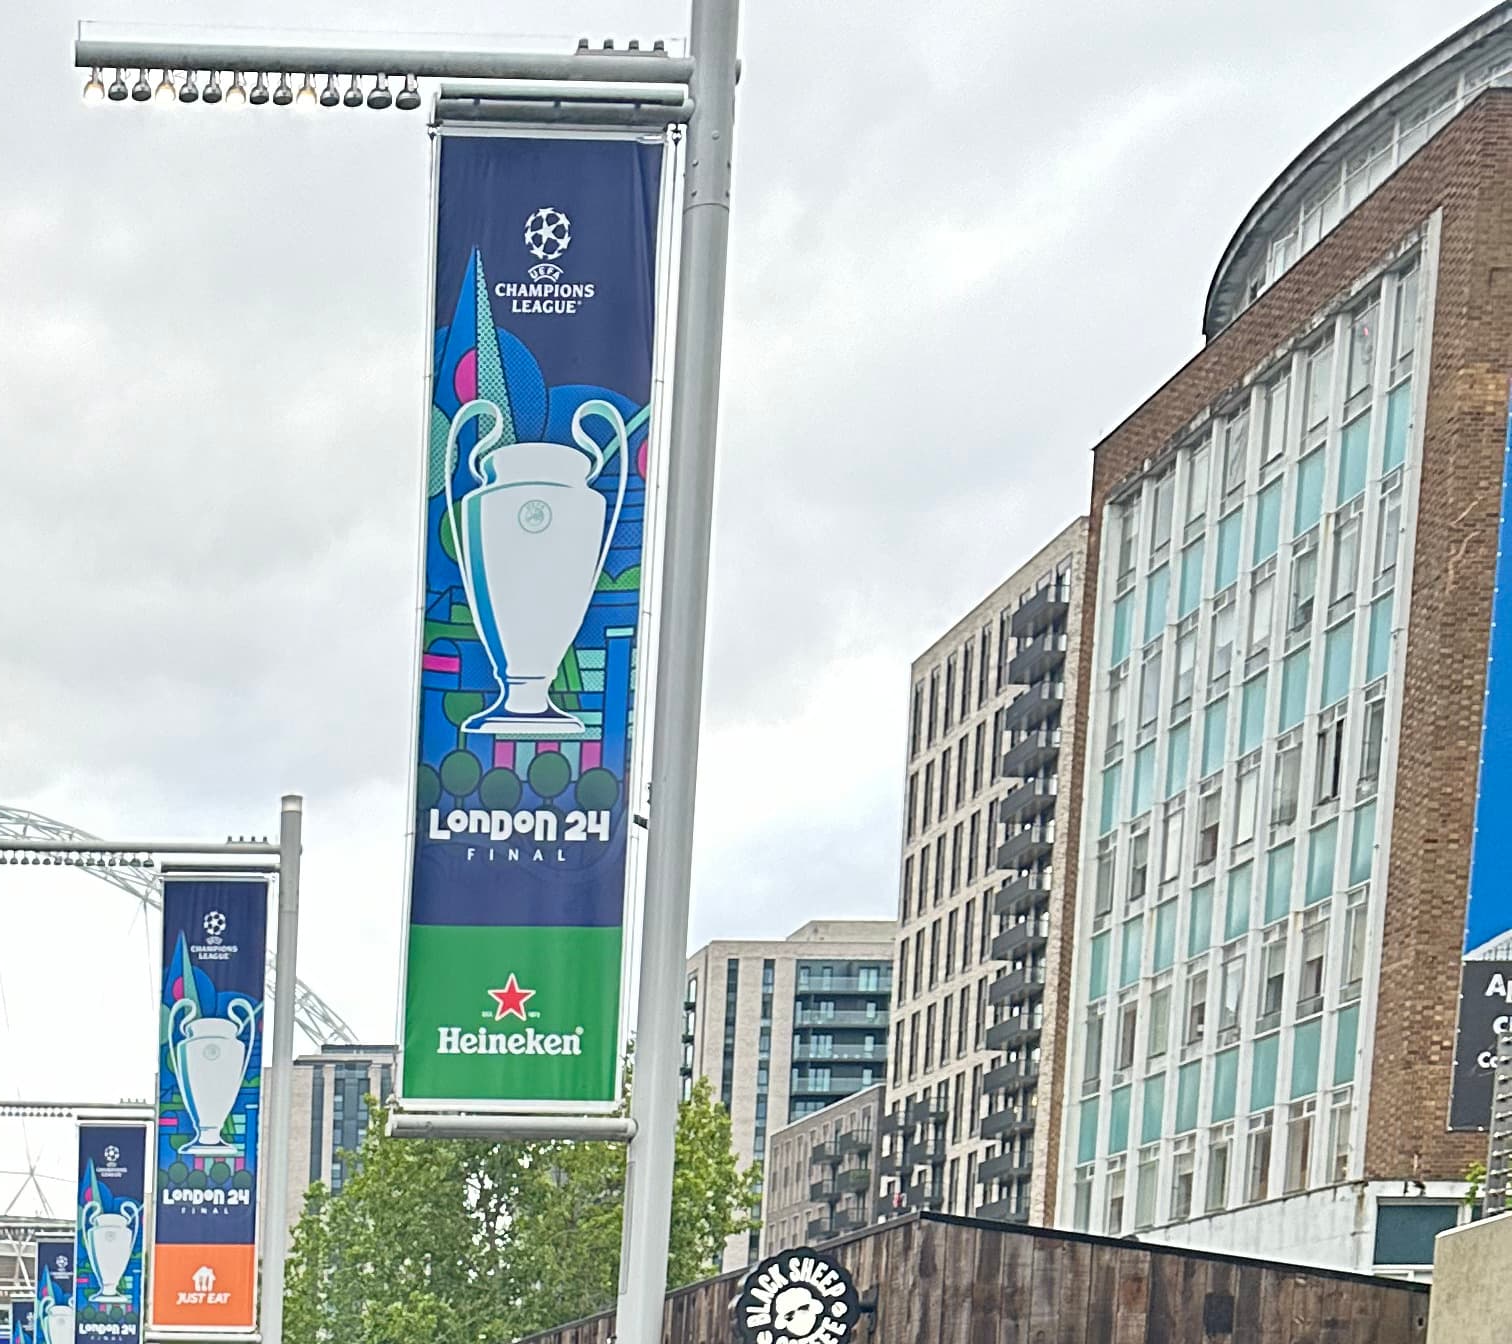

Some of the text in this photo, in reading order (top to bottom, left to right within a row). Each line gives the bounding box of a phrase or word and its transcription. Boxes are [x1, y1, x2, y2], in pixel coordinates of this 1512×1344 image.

[529, 266, 560, 280] UEFA
[494, 283, 595, 298] CHAMPIONS
[512, 299, 577, 313] LEAGUE
[564, 810, 610, 841] 24
[467, 847, 565, 862] FINAL
[437, 1026, 582, 1056] Heineken
[227, 1189, 250, 1205] 24
[176, 1293, 231, 1304] JUST EAT
[746, 1257, 846, 1328] BLACK SHEEP
